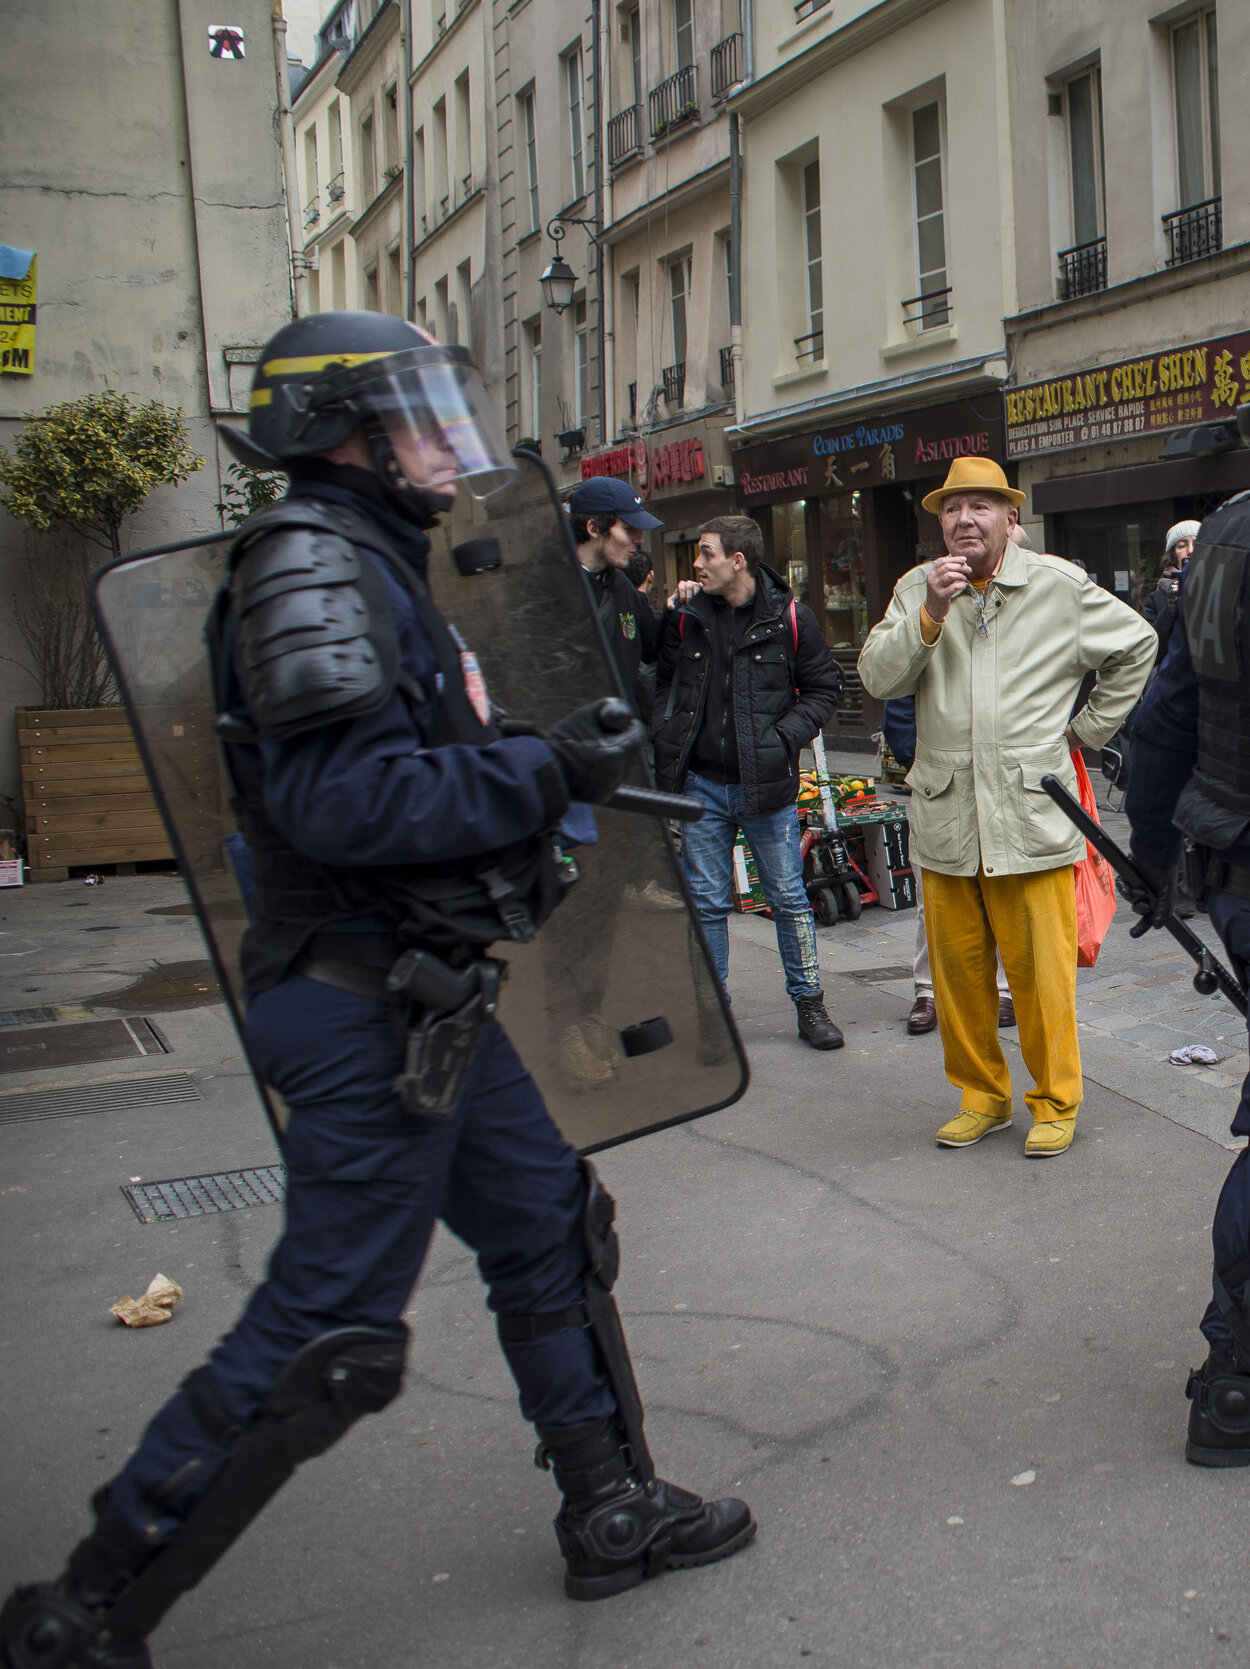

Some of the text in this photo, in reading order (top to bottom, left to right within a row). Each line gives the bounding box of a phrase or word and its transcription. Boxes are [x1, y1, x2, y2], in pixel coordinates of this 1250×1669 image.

[1006, 346, 1208, 425] RESTAURANT CHEZ SHEN
[1008, 400, 1145, 440] DEGUSTATION SUR PLACE SERVICE RAPIDE
[1009, 416, 1145, 454] PLATS A EMPORTER 01 48 87 88 07
[813, 424, 904, 457] COIN DE PARADIS
[914, 432, 989, 464] ASIATIQUE
[740, 466, 808, 496] RESTAURANT
[1187, 560, 1225, 664] 2A
